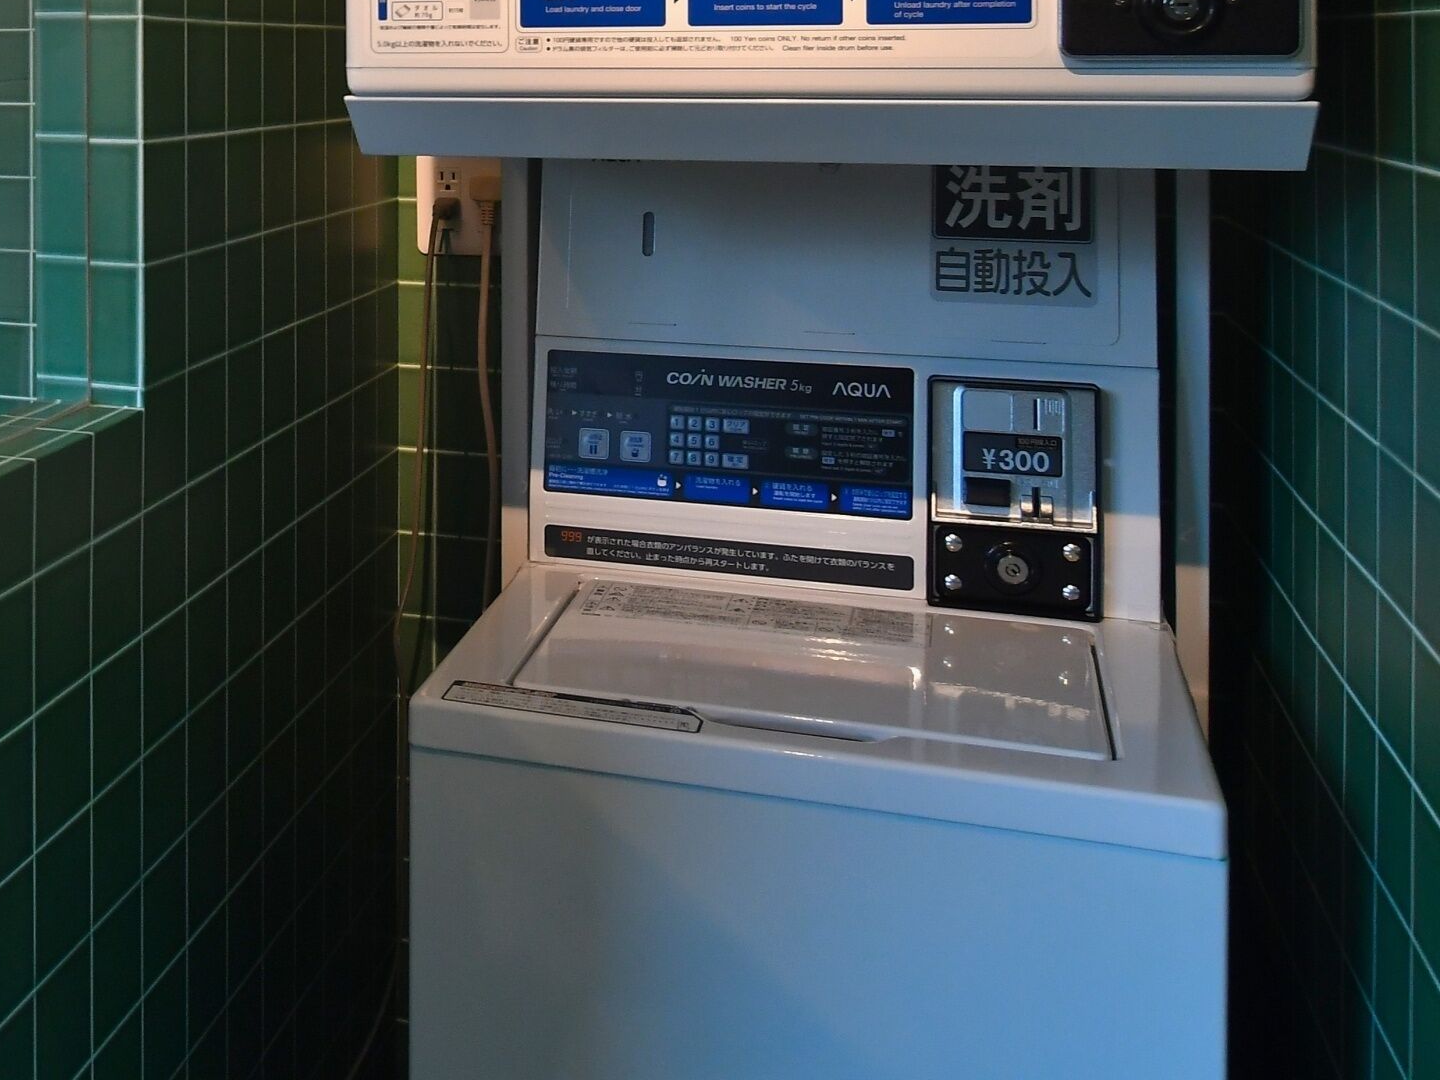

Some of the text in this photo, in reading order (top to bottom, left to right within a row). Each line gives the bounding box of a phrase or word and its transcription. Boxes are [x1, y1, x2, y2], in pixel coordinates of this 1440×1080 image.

[564, 6, 589, 14] laundry
[797, 3, 817, 11] cycle
[923, 1, 951, 10] laundry
[973, 0, 1016, 9] completion
[904, 11, 924, 19] cycle
[945, 165, 1082, 231] 洗剤
[936, 247, 1092, 298] 自動投入
[719, 374, 787, 391] WASHER
[833, 382, 892, 399] AQUA
[982, 448, 1050, 473] ¥300
[561, 531, 582, 542] 999
[587, 548, 770, 571] 直してください。止まった時点から再スタートします。
